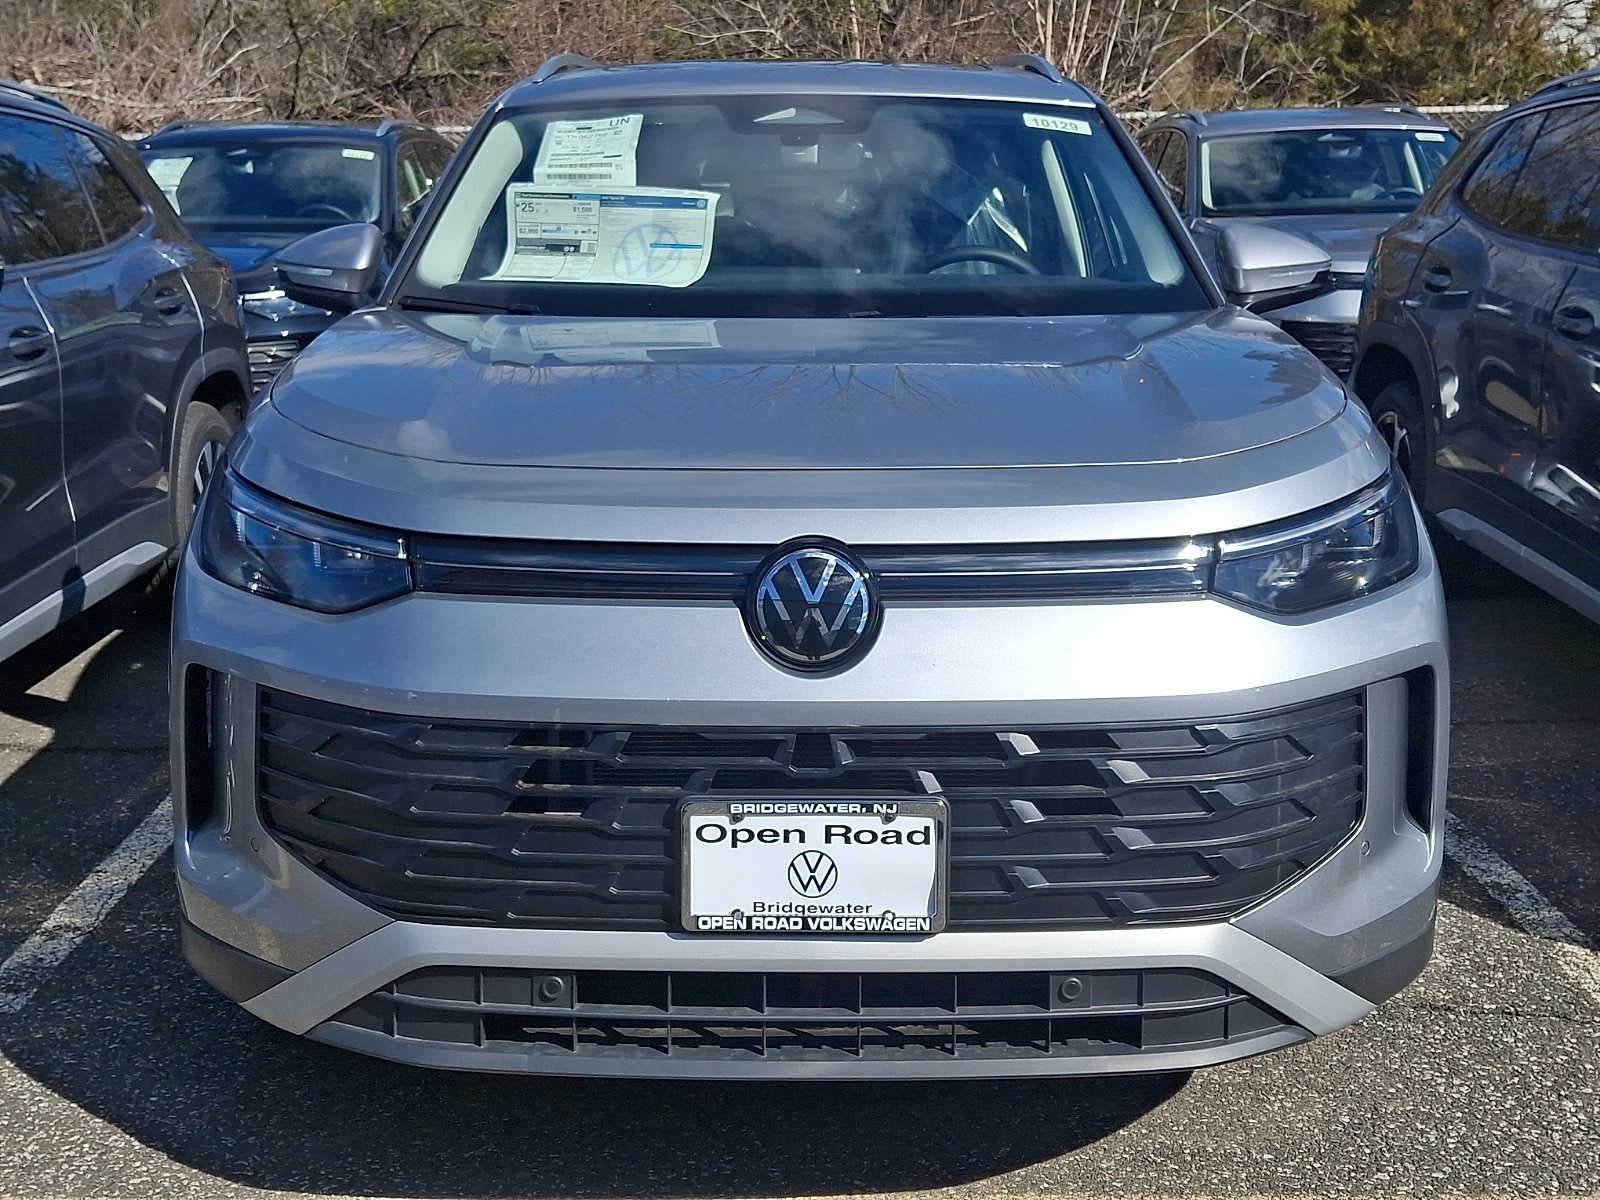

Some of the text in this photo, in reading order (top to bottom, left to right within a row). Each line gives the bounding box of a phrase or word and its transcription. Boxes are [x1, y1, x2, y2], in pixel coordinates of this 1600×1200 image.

[609, 117, 630, 127] UN
[1031, 118, 1079, 131] 10129
[521, 202, 535, 212] 25
[730, 803, 898, 814] BRIDGEWATER, NJ
[695, 823, 931, 848] Open Road
[787, 850, 838, 898] VW
[752, 901, 873, 915] Bridgewater
[698, 916, 931, 931] OPEN ROAD VOLKSWAGEN
